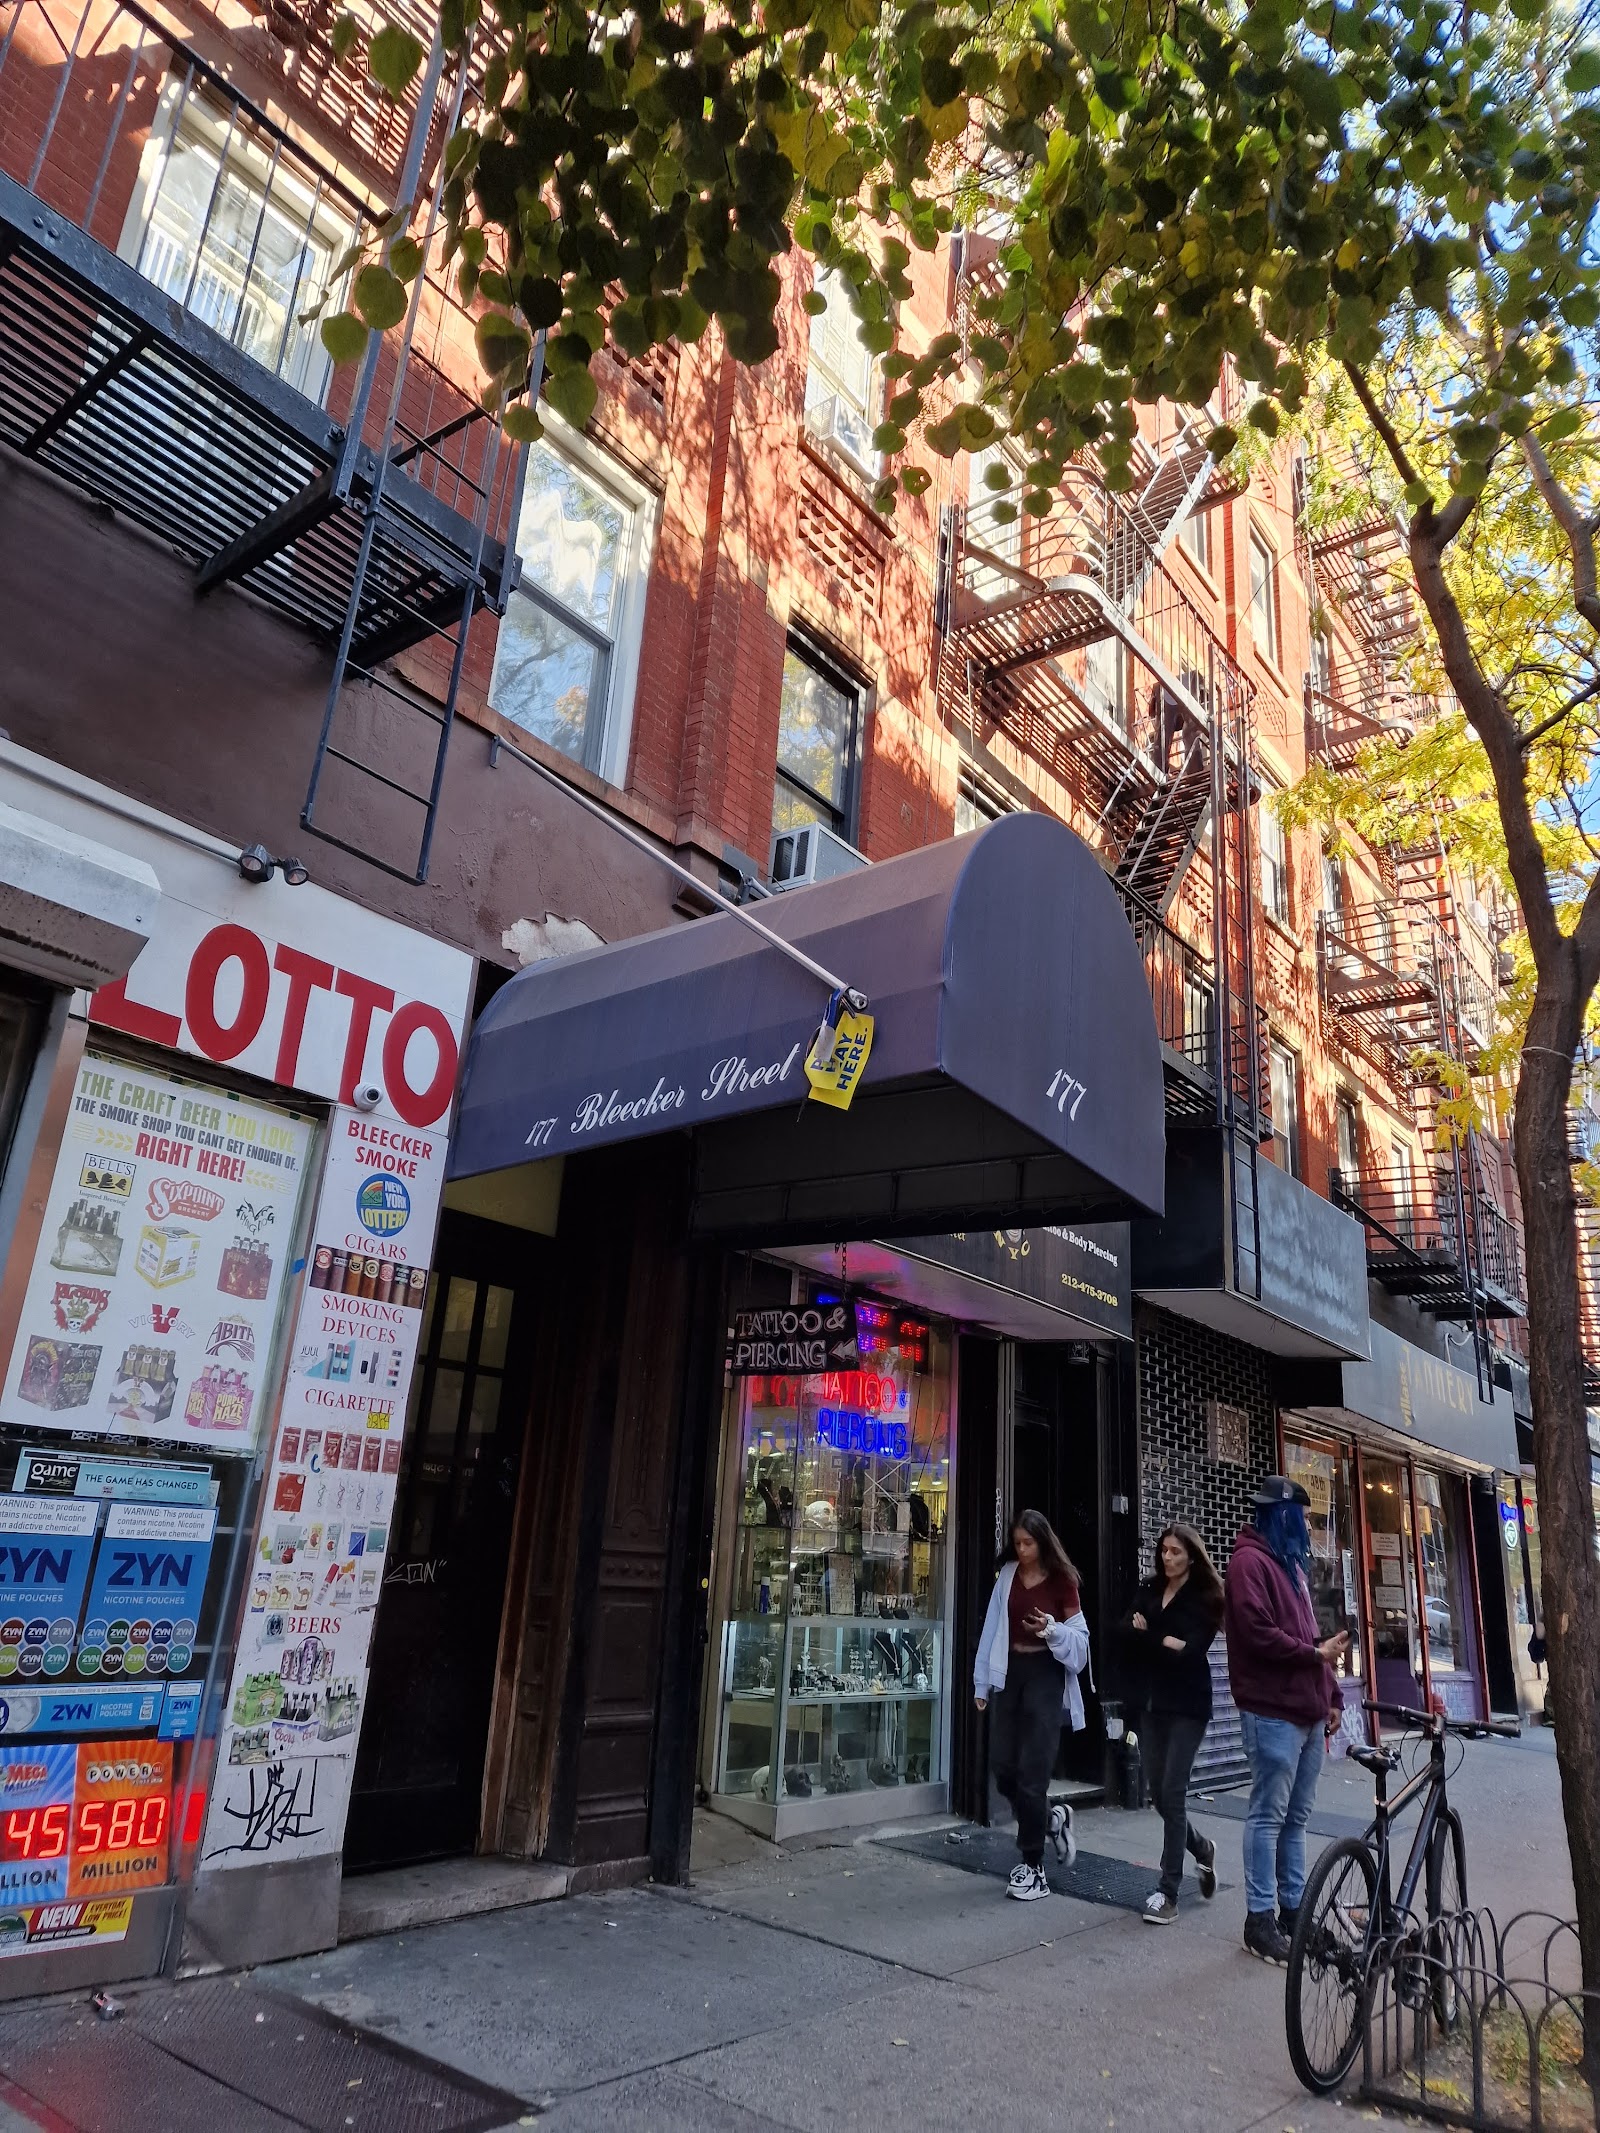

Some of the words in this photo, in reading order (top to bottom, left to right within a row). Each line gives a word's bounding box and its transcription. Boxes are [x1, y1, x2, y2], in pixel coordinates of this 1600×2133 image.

[525, 1117, 558, 1147] 177
[570, 1077, 685, 1133] Bleecker
[701, 1042, 800, 1101] Street
[1045, 1068, 1087, 1121] 177
[80, 1070, 115, 1106] THE
[118, 1081, 176, 1117] CRAFT
[180, 1099, 222, 1131] BEER
[226, 1112, 257, 1142] YOU
[75, 1096, 95, 1115] THE
[99, 1102, 139, 1127] SMOKE
[141, 1114, 172, 1135] SHOP
[175, 1123, 195, 1144] YOU
[197, 1130, 225, 1151] CANT
[227, 1138, 245, 1156] GET
[246, 1143, 285, 1169] ENOUGH
[347, 1120, 433, 1160] BLEECKER
[87, 1156, 132, 1176] BELL'S
[135, 1132, 193, 1169] RIGHT
[196, 1148, 246, 1183] HERE!
[355, 1147, 418, 1178] SMOKE
[385, 1181, 403, 1194] NEW
[385, 1193, 407, 1209] YORK
[361, 1208, 408, 1230] LOTTERY
[345, 1234, 407, 1260] CIGARS
[1062, 1229, 1068, 1240] &
[1069, 1231, 1088, 1252] Body
[1088, 1240, 1119, 1267] Piercing
[1061, 1273, 1119, 1307] 212-475-3708
[321, 1294, 404, 1323] SMOKING
[128, 1313, 196, 1339] VICTORY
[322, 1317, 396, 1344] DEVICES
[736, 1311, 822, 1337] TATTOO
[825, 1307, 847, 1331] &
[206, 1321, 255, 1349] ABITA
[733, 1340, 826, 1369] PIERCING
[305, 1388, 396, 1415] CIGARETTE
[213, 1404, 244, 1422] HAZE
[31, 1462, 78, 1485] game
[85, 1474, 103, 1483] THE
[105, 1476, 134, 1486] GAME
[135, 1479, 154, 1487] HAS
[156, 1480, 199, 1491] CHANGED
[40, 1502, 55, 1510] This
[55, 1504, 85, 1512] product
[123, 1507, 160, 1517] WARNING:
[56, 1513, 87, 1522] Nicotine
[178, 1521, 205, 1529] Nicotine
[8, 1522, 43, 1531] addictive
[136, 1529, 167, 1537] addictive
[0, 1547, 73, 1583] YN
[107, 1552, 193, 1587] ZYN
[18, 1594, 63, 1602] POUCHES
[103, 1596, 145, 1604] NICOTINE
[146, 1596, 185, 1605] POUCHES
[3, 1628, 22, 1636] ZYN
[28, 1628, 47, 1636] ZYN
[52, 1628, 71, 1636] ZYN
[88, 1629, 104, 1637] ZYN
[110, 1628, 127, 1636] ZYN
[133, 1628, 150, 1636] ZYN
[154, 1628, 171, 1636] ZYN
[176, 1627, 192, 1635] ZYN
[286, 1616, 342, 1634] BEERS
[22, 1654, 41, 1663] ZYN
[47, 1654, 65, 1662] ZYN
[82, 1654, 99, 1663] ZYN
[105, 1654, 122, 1662] ZYN
[128, 1654, 144, 1662] ZYN
[150, 1653, 166, 1661] ZYN
[171, 1653, 187, 1661] ZYN
[51, 1703, 93, 1721] ZYN
[100, 1703, 133, 1711] NICOTINE
[99, 1709, 133, 1717] POUCHES
[173, 1701, 193, 1710] ZYN
[7, 1763, 47, 1779] MEGA
[88, 1764, 150, 1781] POWER
[8, 1805, 68, 1858] 45
[77, 1797, 166, 1853] 580
[81, 1856, 158, 1880] MILLION
[91, 1899, 126, 1912] EVERYDAY
[36, 1903, 83, 1930] NEW
[86, 1912, 101, 1924] LOW
[102, 1908, 127, 1920] PRICE!
